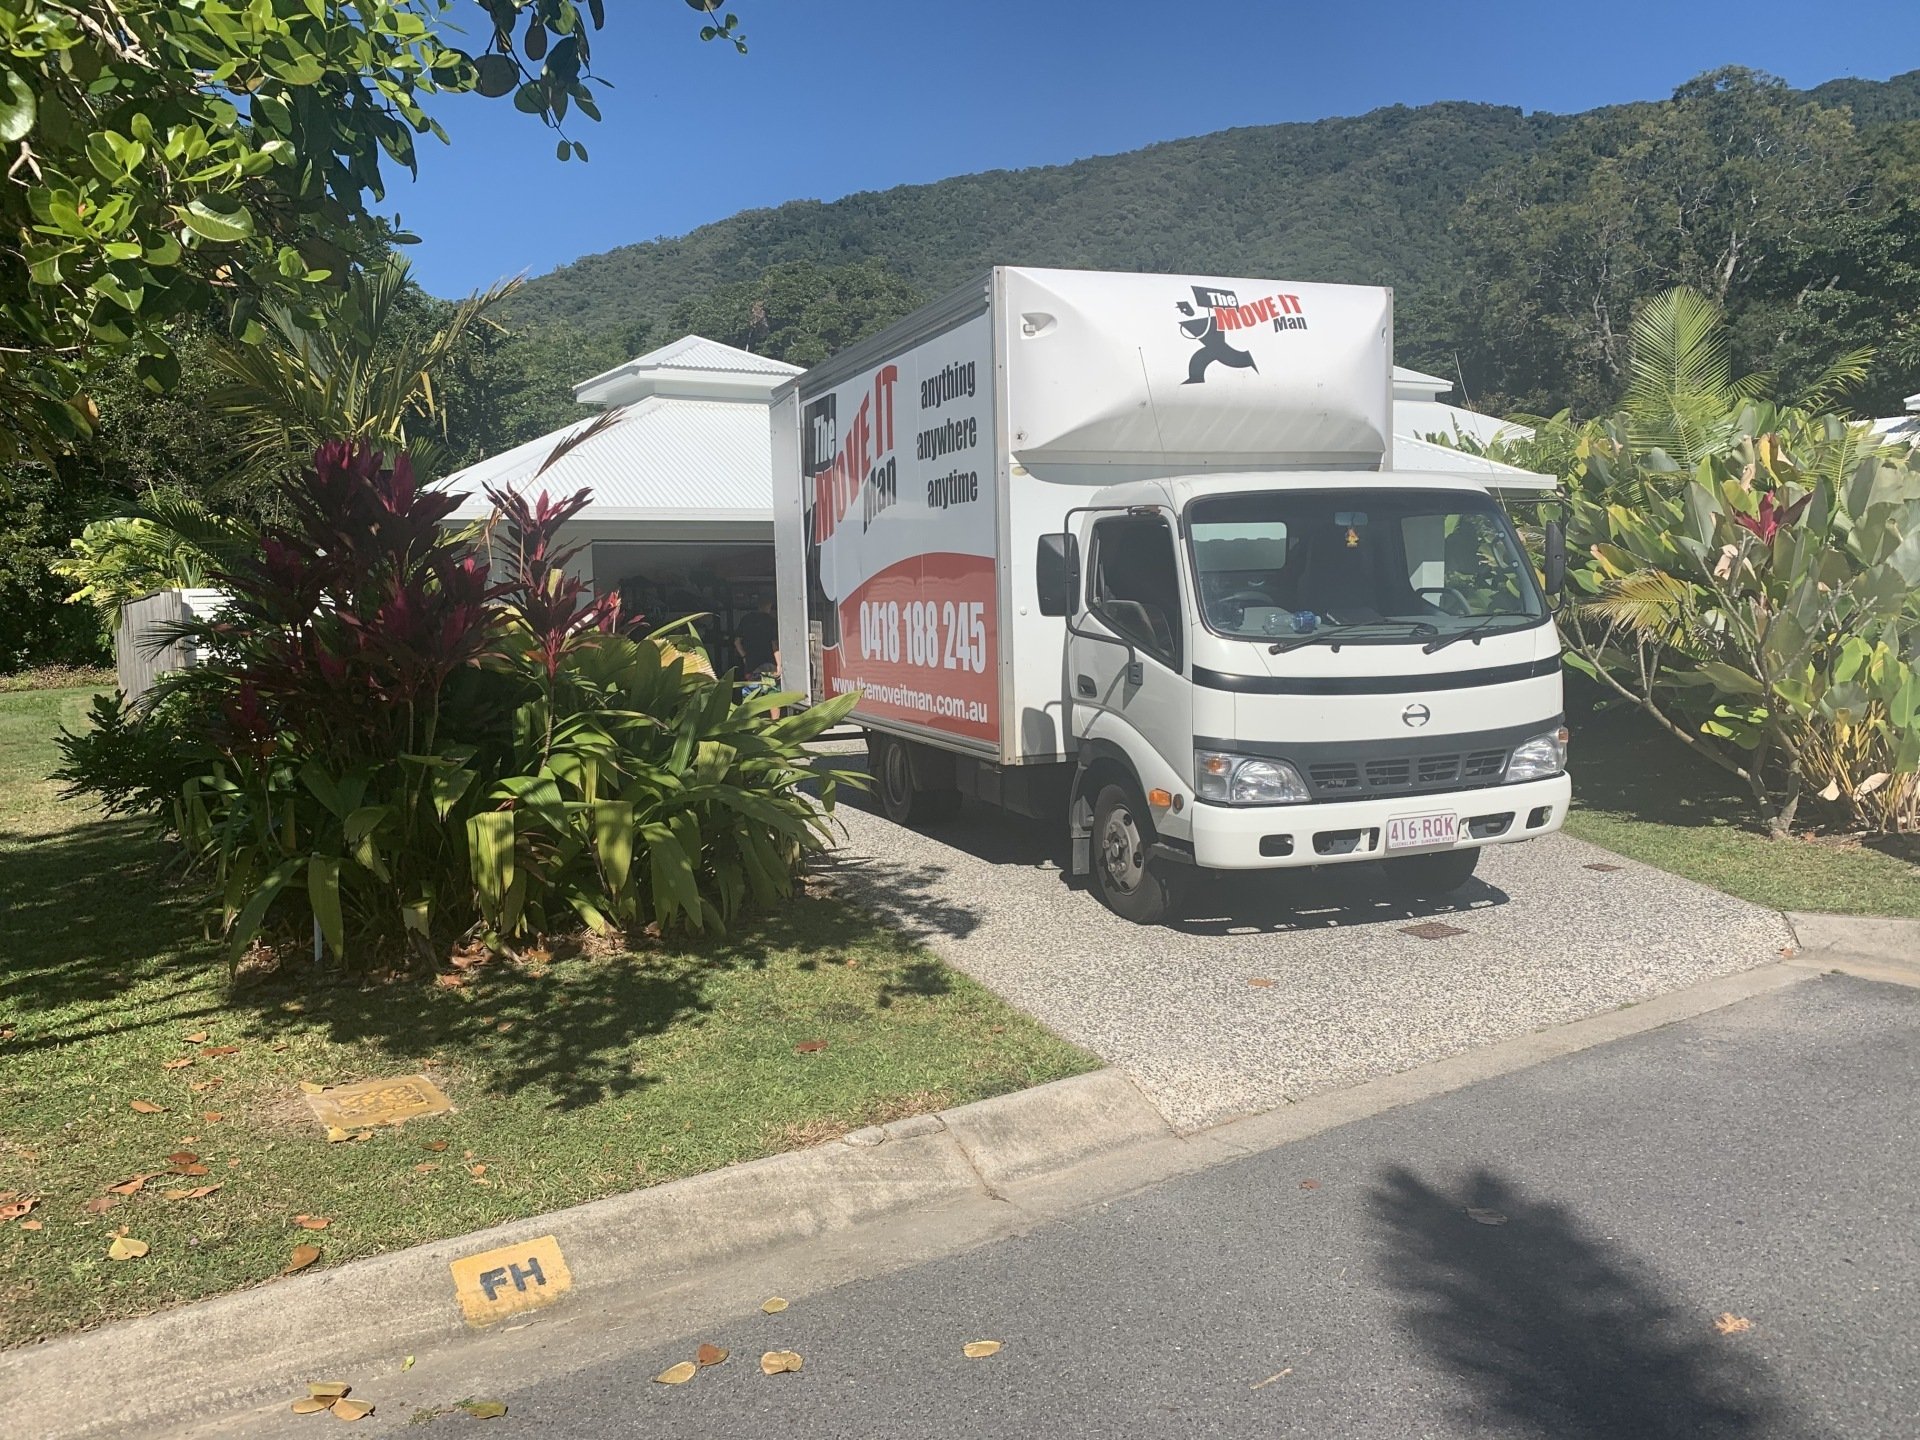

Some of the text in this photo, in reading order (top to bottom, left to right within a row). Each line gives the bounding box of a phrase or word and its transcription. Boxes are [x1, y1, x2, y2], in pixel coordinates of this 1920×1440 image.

[1207, 292, 1237, 307] The
[1214, 294, 1303, 332] MOVE IT
[1273, 316, 1308, 333] Man
[921, 360, 975, 410] anything
[813, 414, 835, 465] The
[815, 365, 897, 545] MOVE IT
[916, 416, 977, 462] anywhere
[863, 455, 897, 536] Man
[927, 468, 978, 510] anytime
[859, 600, 986, 674] 0418 188 245
[831, 675, 988, 724] wwwthemoveitman.com.au
[479, 1257, 547, 1301] FH
